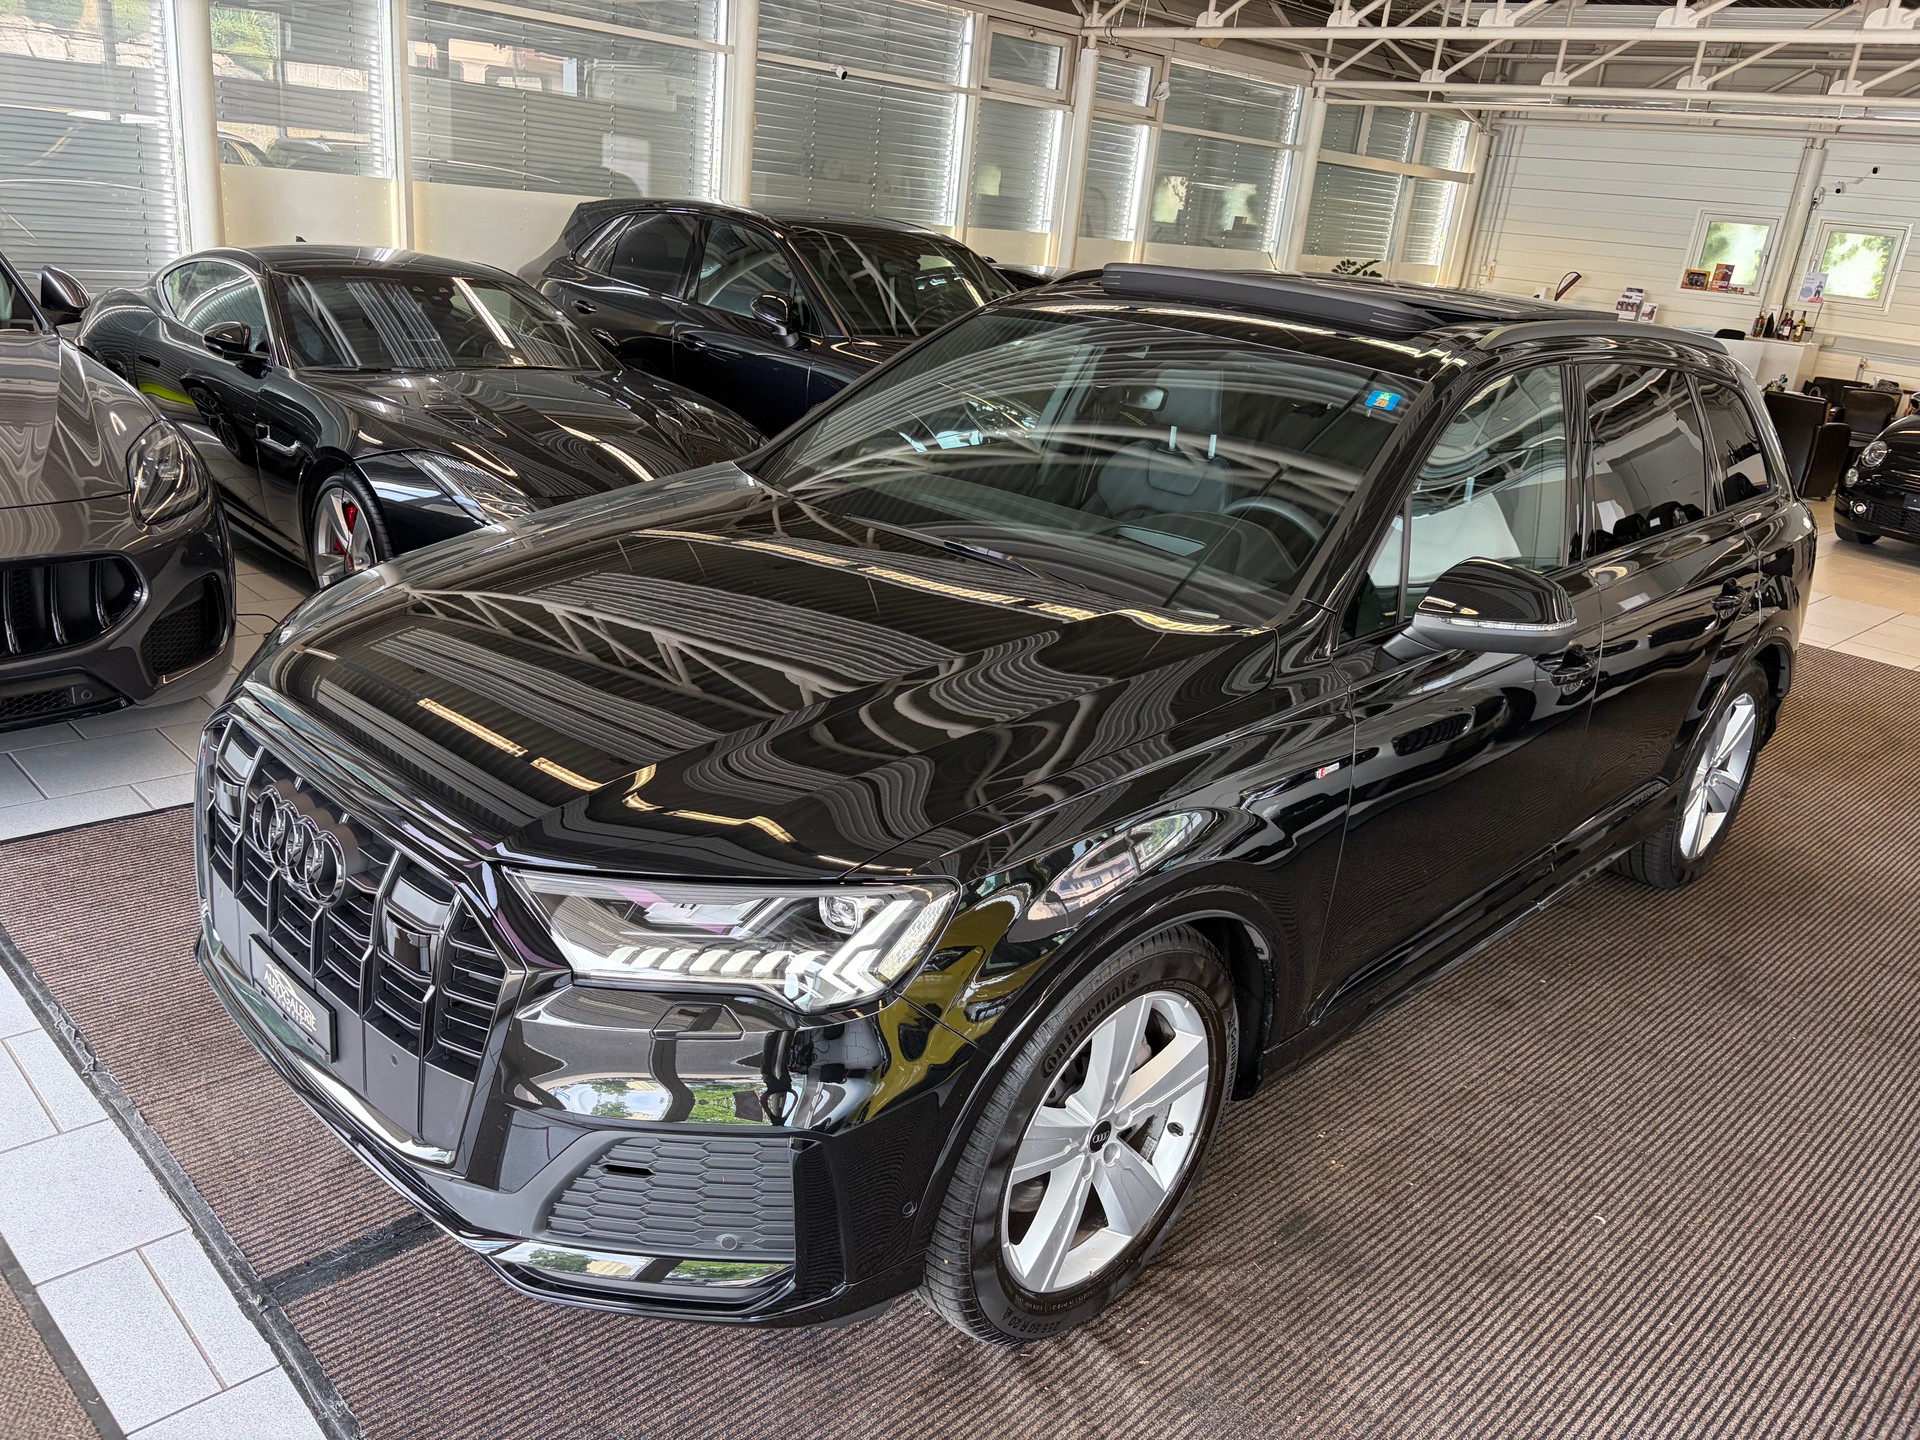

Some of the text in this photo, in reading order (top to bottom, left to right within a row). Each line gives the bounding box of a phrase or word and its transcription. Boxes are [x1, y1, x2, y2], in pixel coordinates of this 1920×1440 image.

[263, 970, 316, 1031] AUTOGALERIE
[1040, 982, 1126, 1078] Continental
[1008, 1315, 1020, 1328] 20
[1021, 1321, 1028, 1329] R
